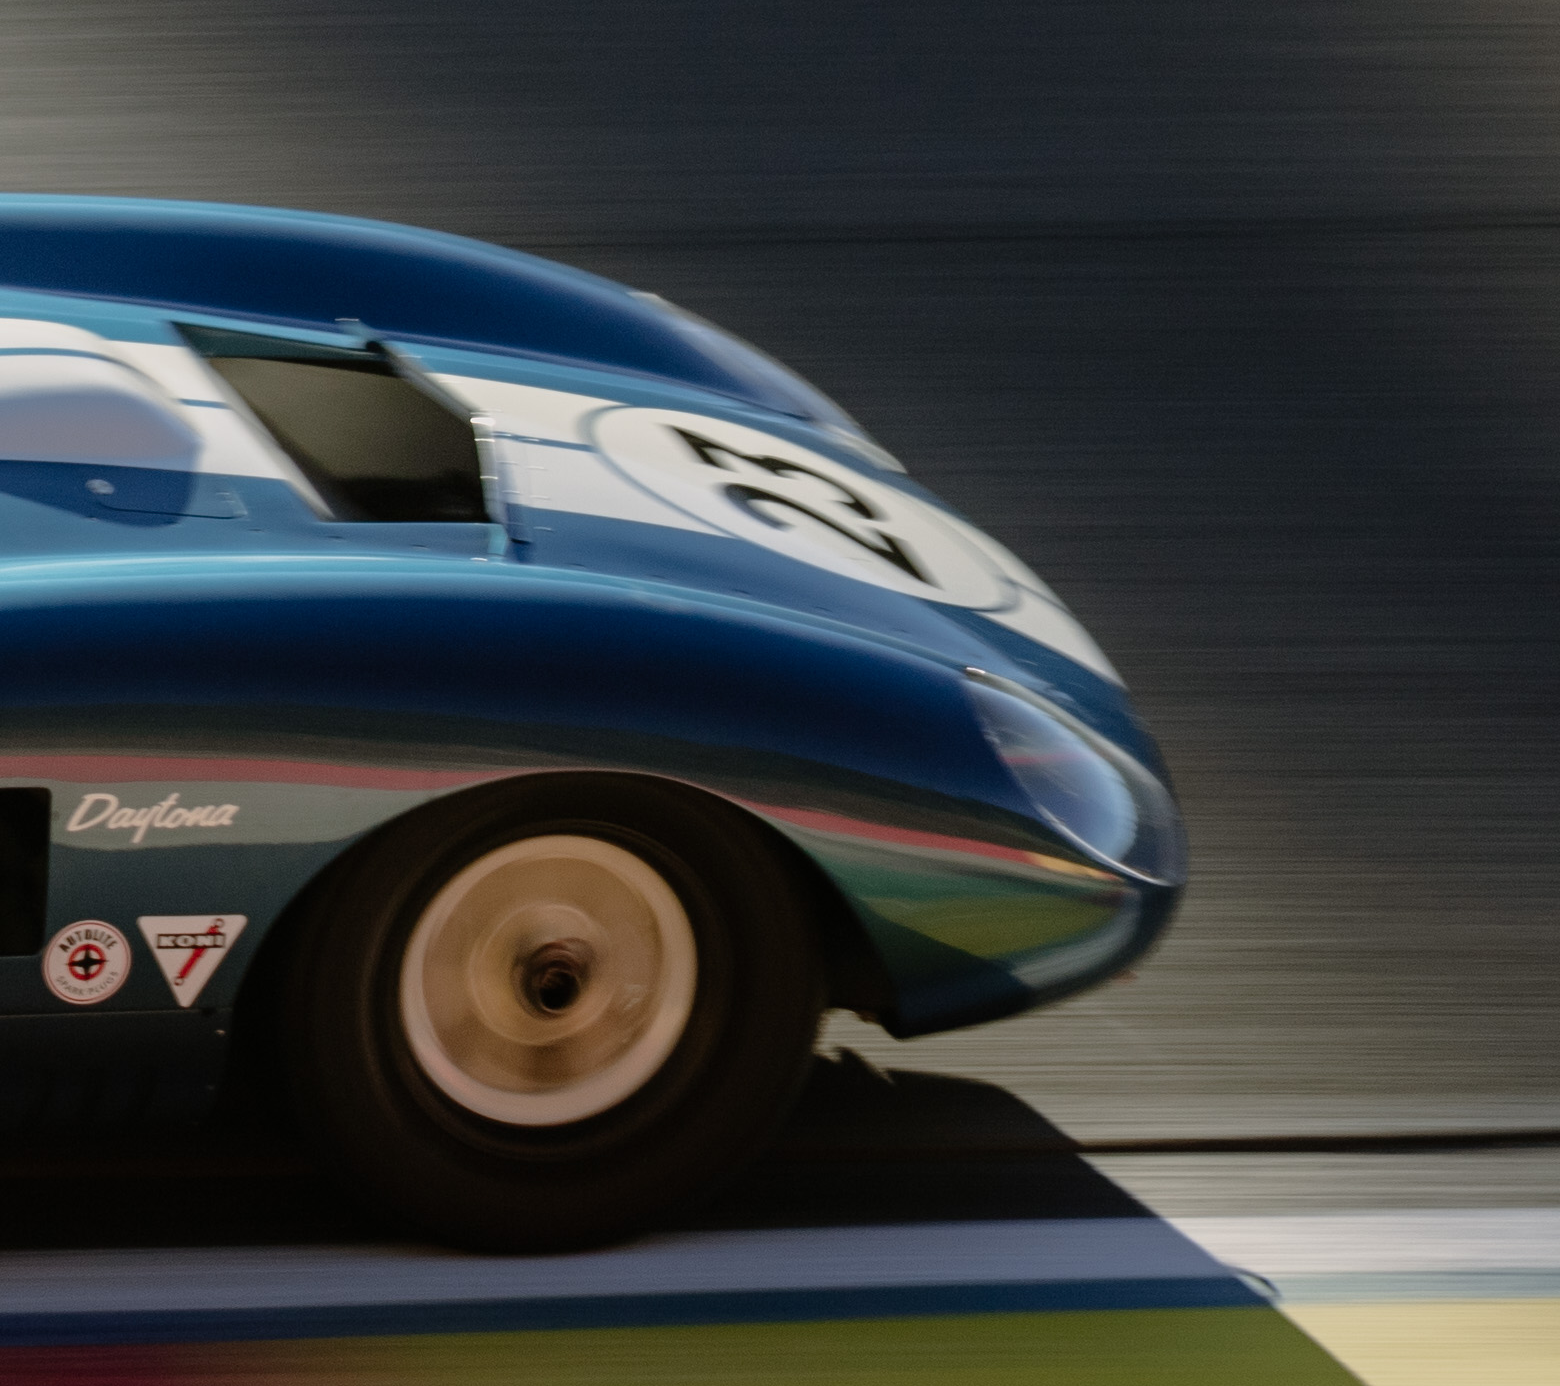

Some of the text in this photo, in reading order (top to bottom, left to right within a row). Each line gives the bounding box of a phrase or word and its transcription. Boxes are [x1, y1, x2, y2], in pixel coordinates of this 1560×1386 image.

[659, 423, 943, 590] 23
[66, 792, 241, 845] Daytona
[59, 929, 118, 953] AUTOLITE
[157, 933, 226, 949] KONI
